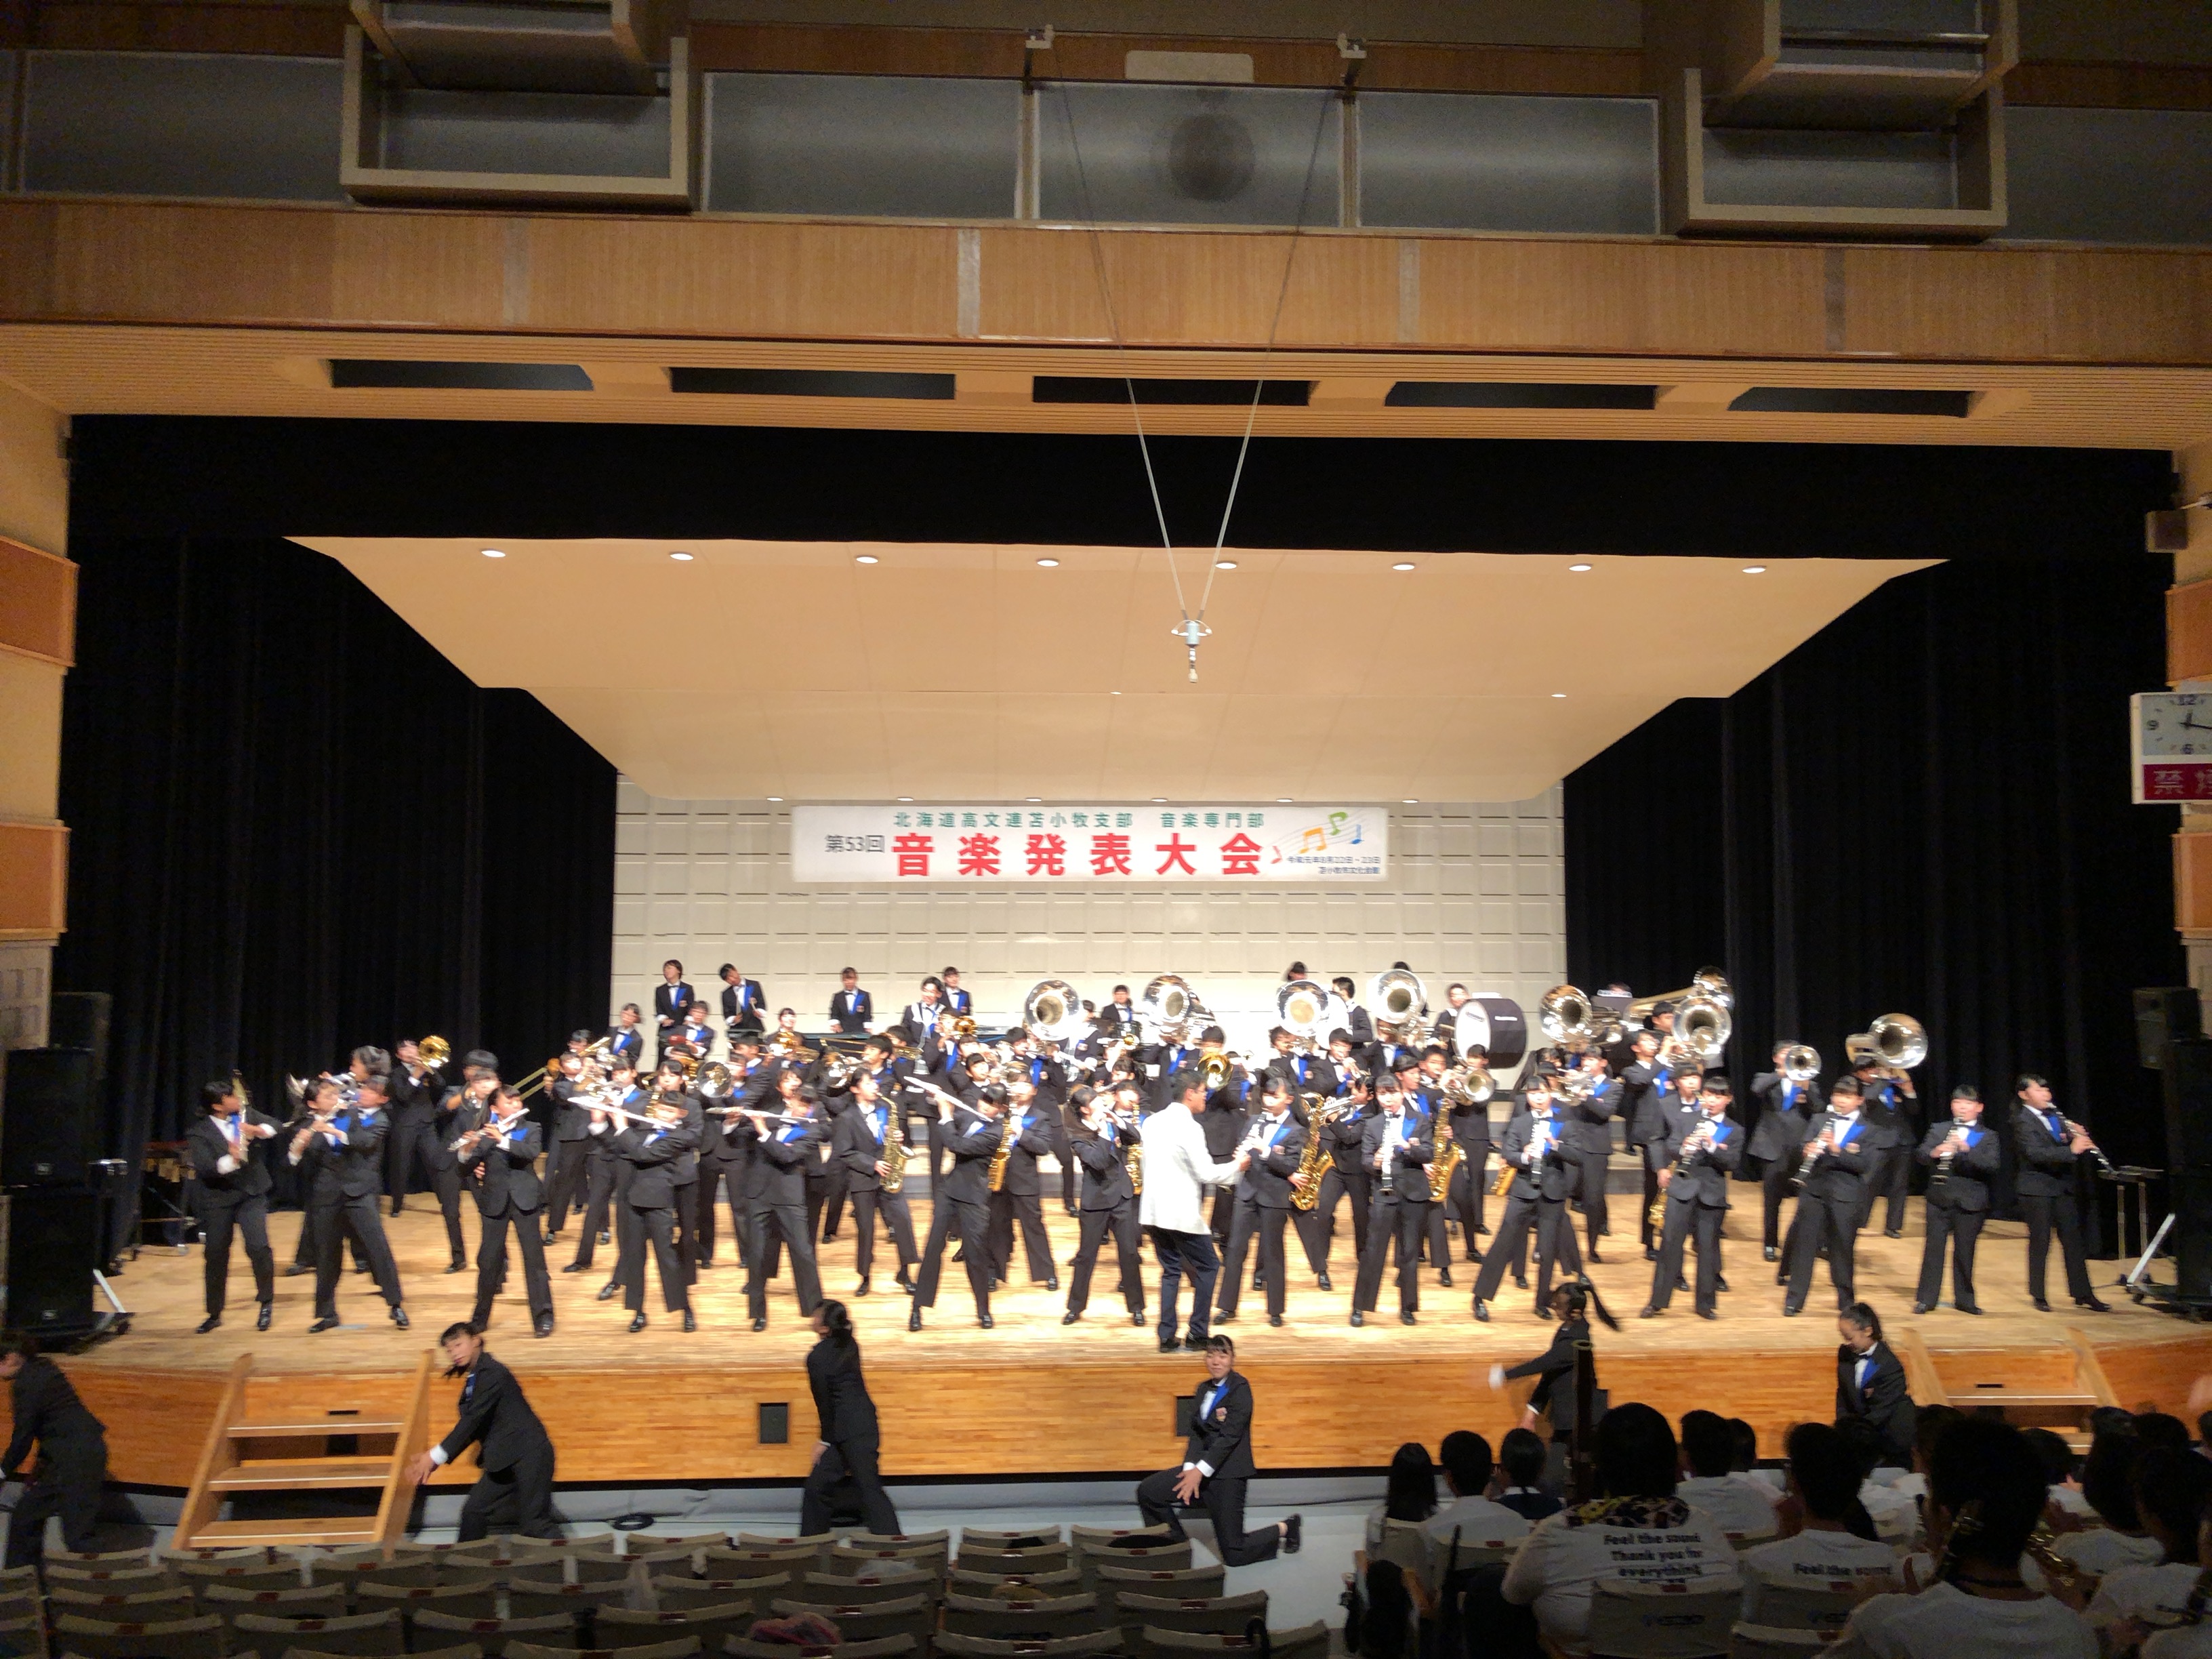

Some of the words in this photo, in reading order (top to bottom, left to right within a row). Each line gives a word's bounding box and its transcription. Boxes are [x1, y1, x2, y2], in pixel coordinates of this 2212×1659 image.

[893, 812, 1134, 828] 北海道高文連苫小牧支部
[1160, 812, 1265, 828] 音楽専門部
[825, 834, 886, 853] 第53回
[891, 832, 1263, 876] 音楽発表大会
[1603, 1533, 1634, 1544] Feel
[1637, 1532, 1663, 1544] the
[1610, 1549, 1656, 1561] Thank
[1658, 1551, 1685, 1562] you
[1792, 1562, 1824, 1574] Feel
